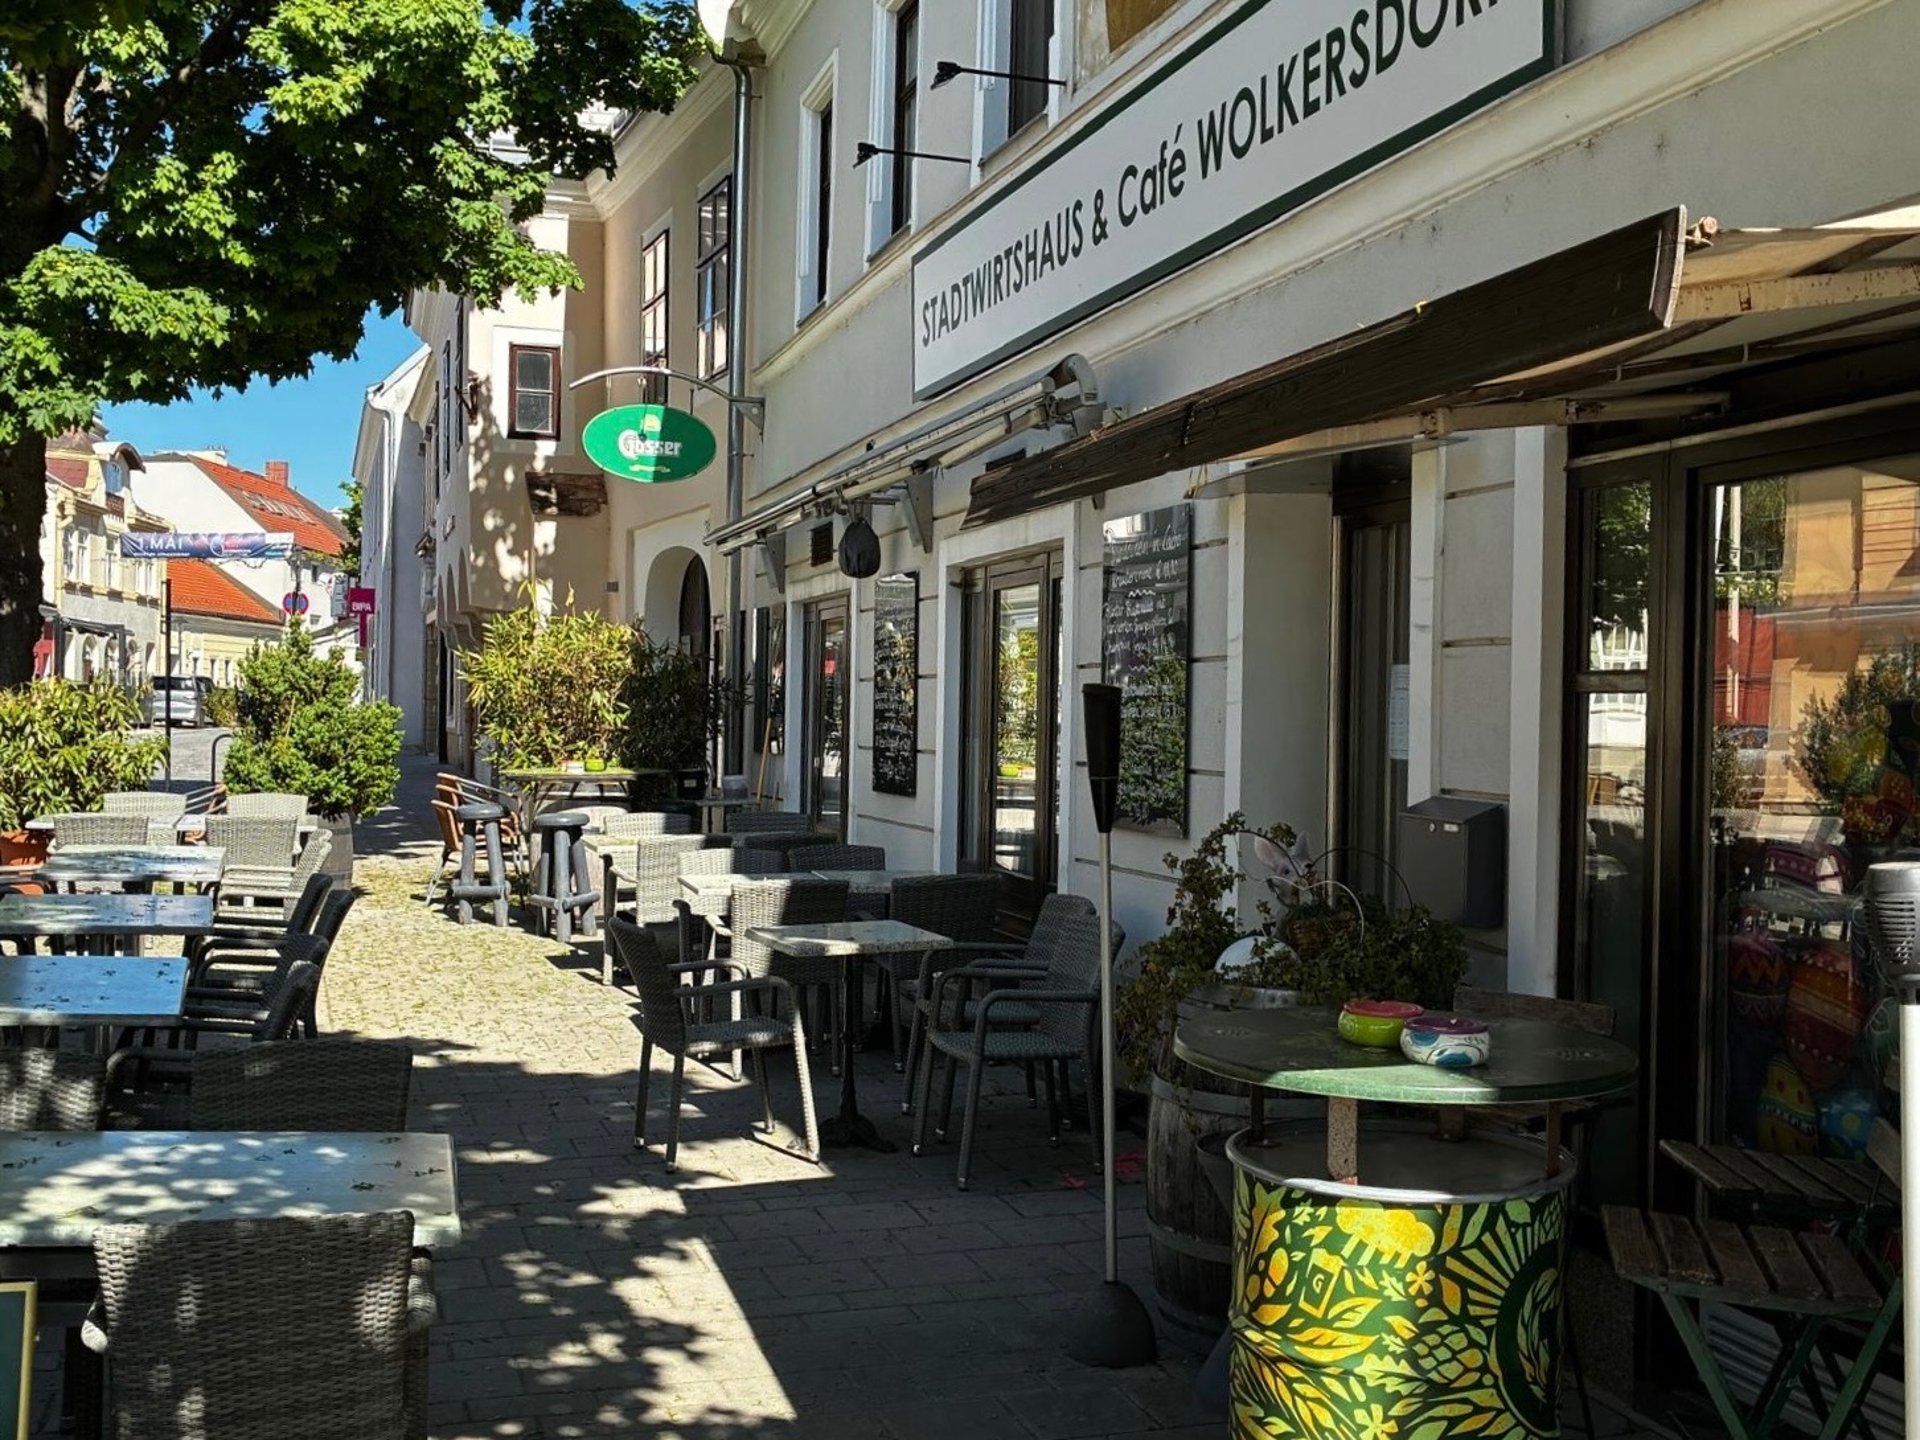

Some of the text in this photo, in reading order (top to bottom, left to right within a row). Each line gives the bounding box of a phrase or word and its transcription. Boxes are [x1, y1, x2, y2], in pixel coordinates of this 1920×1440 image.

[922, 0, 1498, 348] STADTWIRTSHAUS & Café WOLKERSDO
